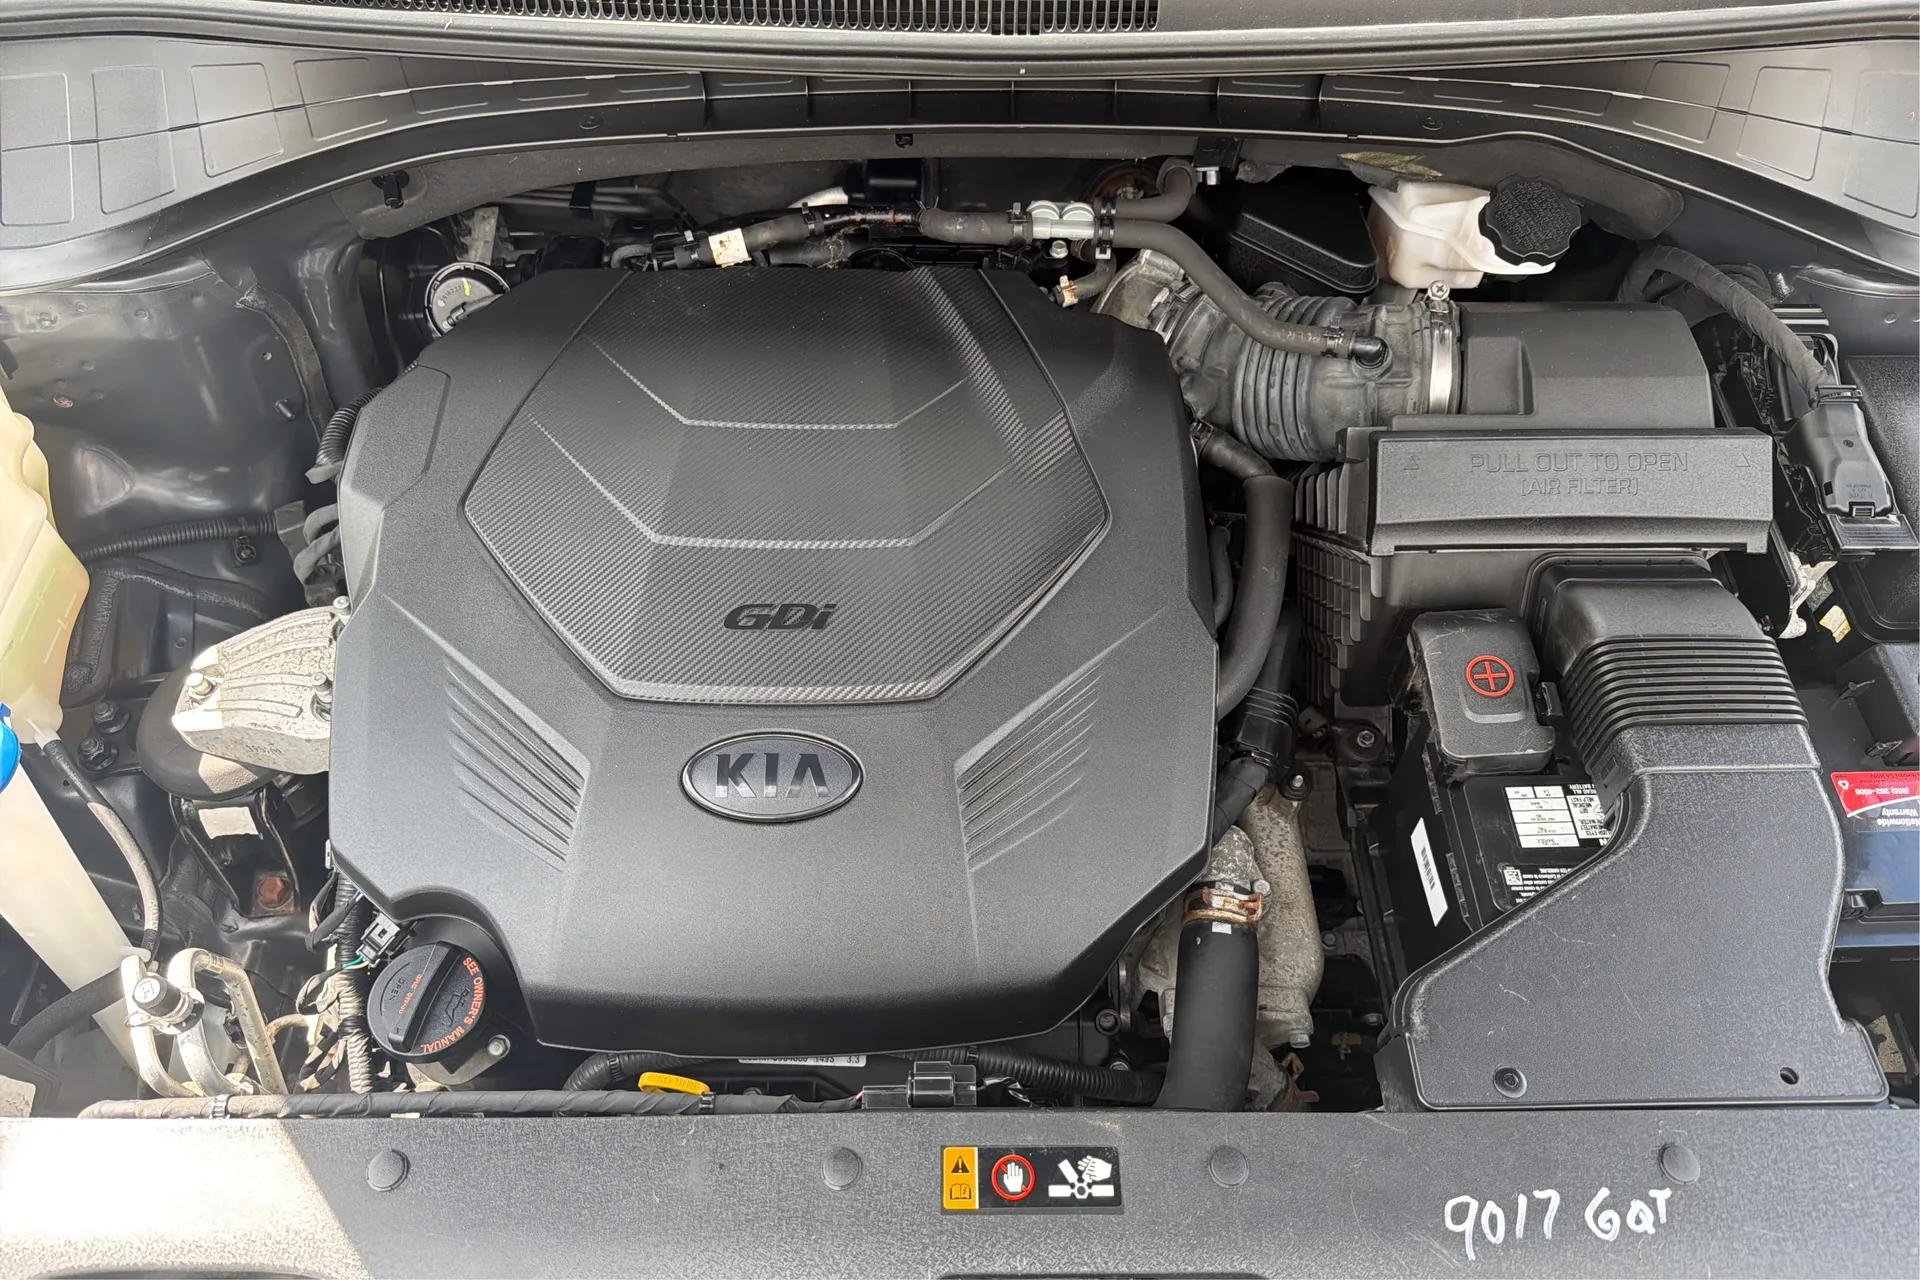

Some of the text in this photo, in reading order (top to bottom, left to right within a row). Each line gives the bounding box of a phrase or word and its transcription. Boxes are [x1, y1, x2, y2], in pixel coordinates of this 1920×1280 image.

[1469, 452, 1689, 473] PULL OUT TO OPEN
[723, 602, 837, 631] GDi
[714, 751, 830, 800] KIA
[1881, 807, 1918, 817] Warranty
[389, 977, 406, 1001] OPEN
[420, 956, 485, 1054] SEE OWNER'S MANUAL
[1444, 1188, 1560, 1260] 9017
